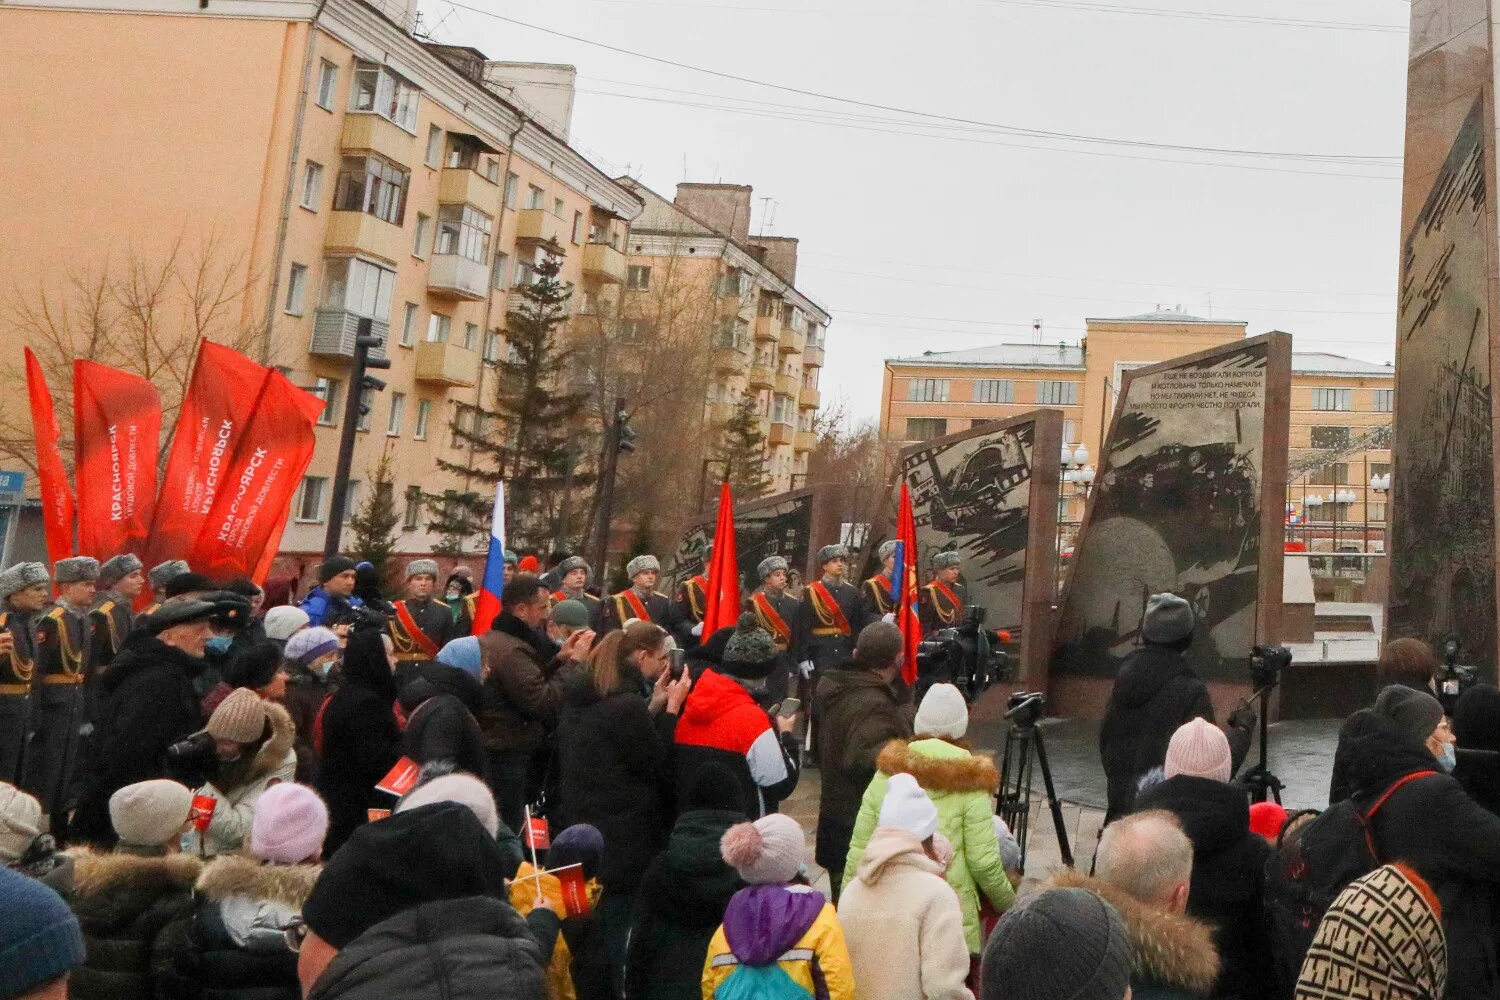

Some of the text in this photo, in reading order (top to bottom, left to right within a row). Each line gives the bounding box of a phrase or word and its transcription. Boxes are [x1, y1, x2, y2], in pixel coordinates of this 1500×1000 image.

[1233, 370, 1263, 378] КОРПУСА
[1158, 382, 1196, 390] КОТЛОВАНЫ
[1198, 381, 1224, 389] ТОЛЬКО
[1219, 391, 1229, 399] НЕ
[1141, 402, 1168, 410] ПРОСТО
[1168, 402, 1195, 410] ФРОНТУ
[255, 458, 285, 505] ДОБЛЕСТИ
